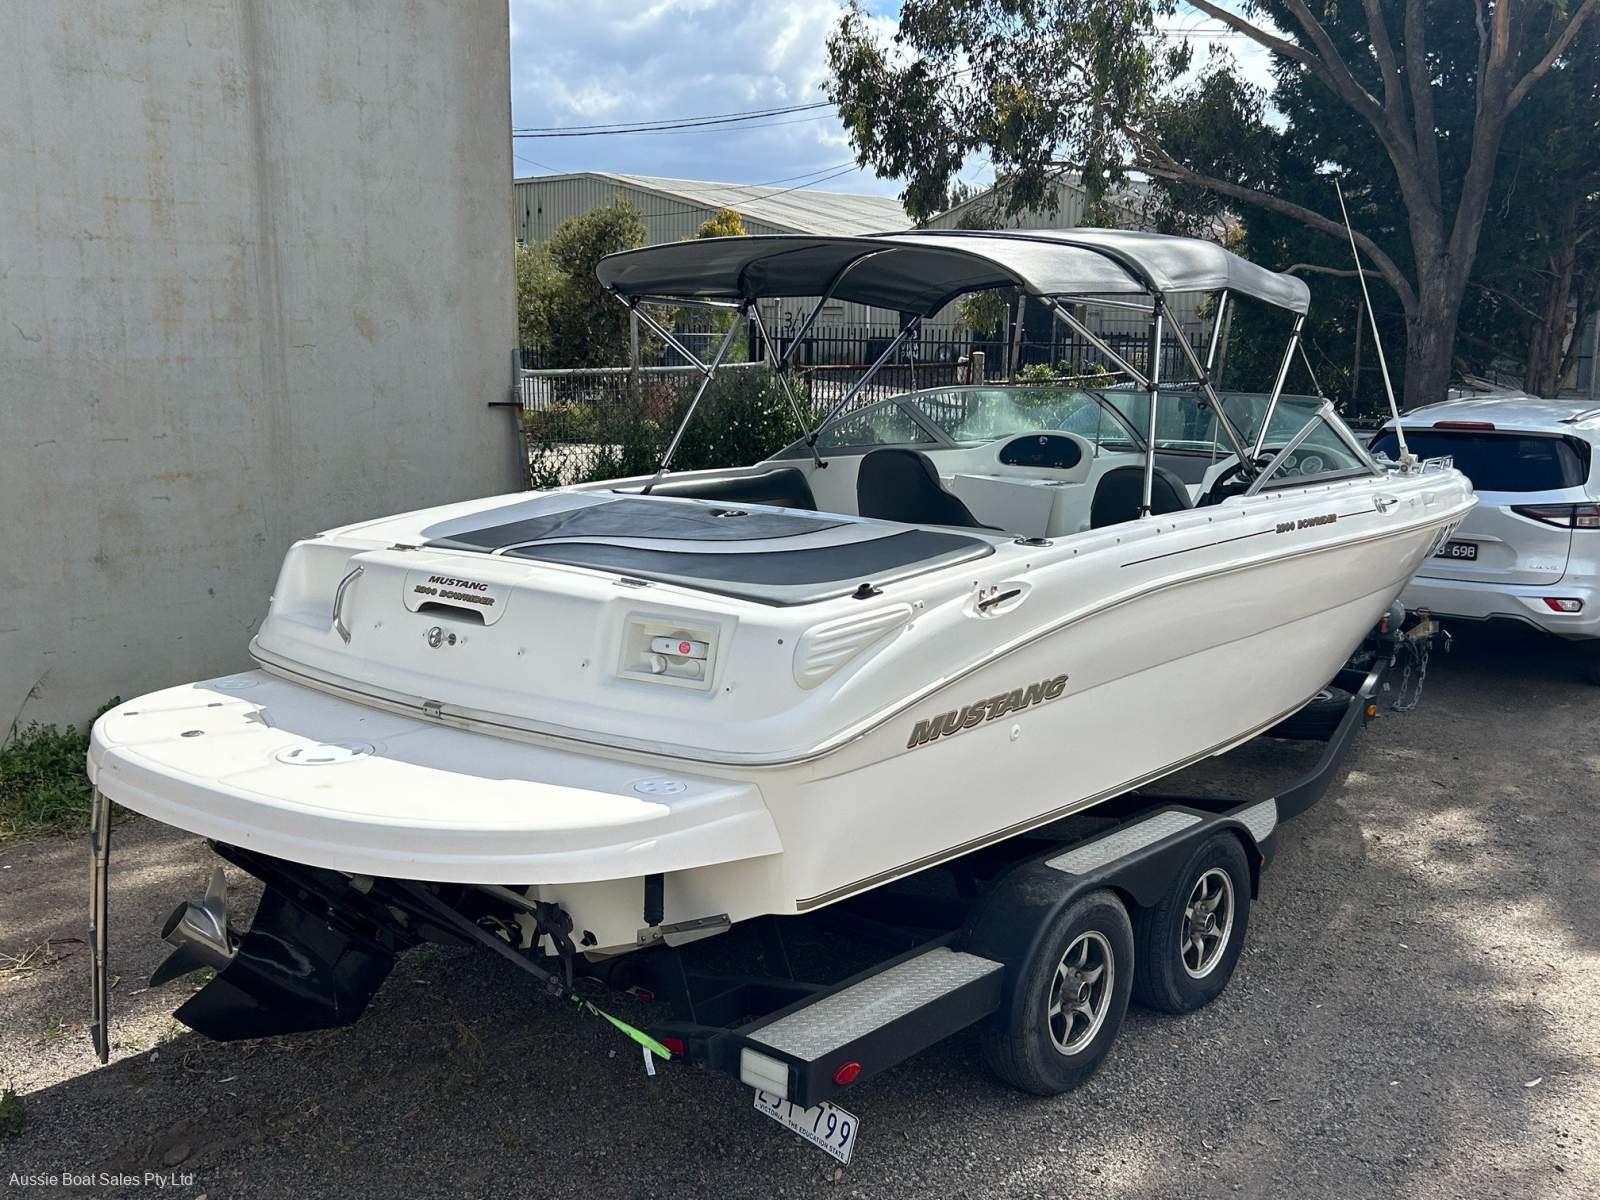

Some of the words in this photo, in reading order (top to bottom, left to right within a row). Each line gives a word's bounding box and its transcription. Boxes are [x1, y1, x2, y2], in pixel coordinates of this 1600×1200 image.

[1298, 514, 1337, 529] BOWRIDER
[428, 576, 488, 591] MUSTANG
[440, 590, 495, 606] BOWRIDER
[906, 674, 1069, 749] MUSTANG
[759, 1103, 784, 1121] VICTORIA
[788, 1120, 799, 1131] THE
[798, 1126, 829, 1149] EDUCATION
[828, 1145, 846, 1160] STATE
